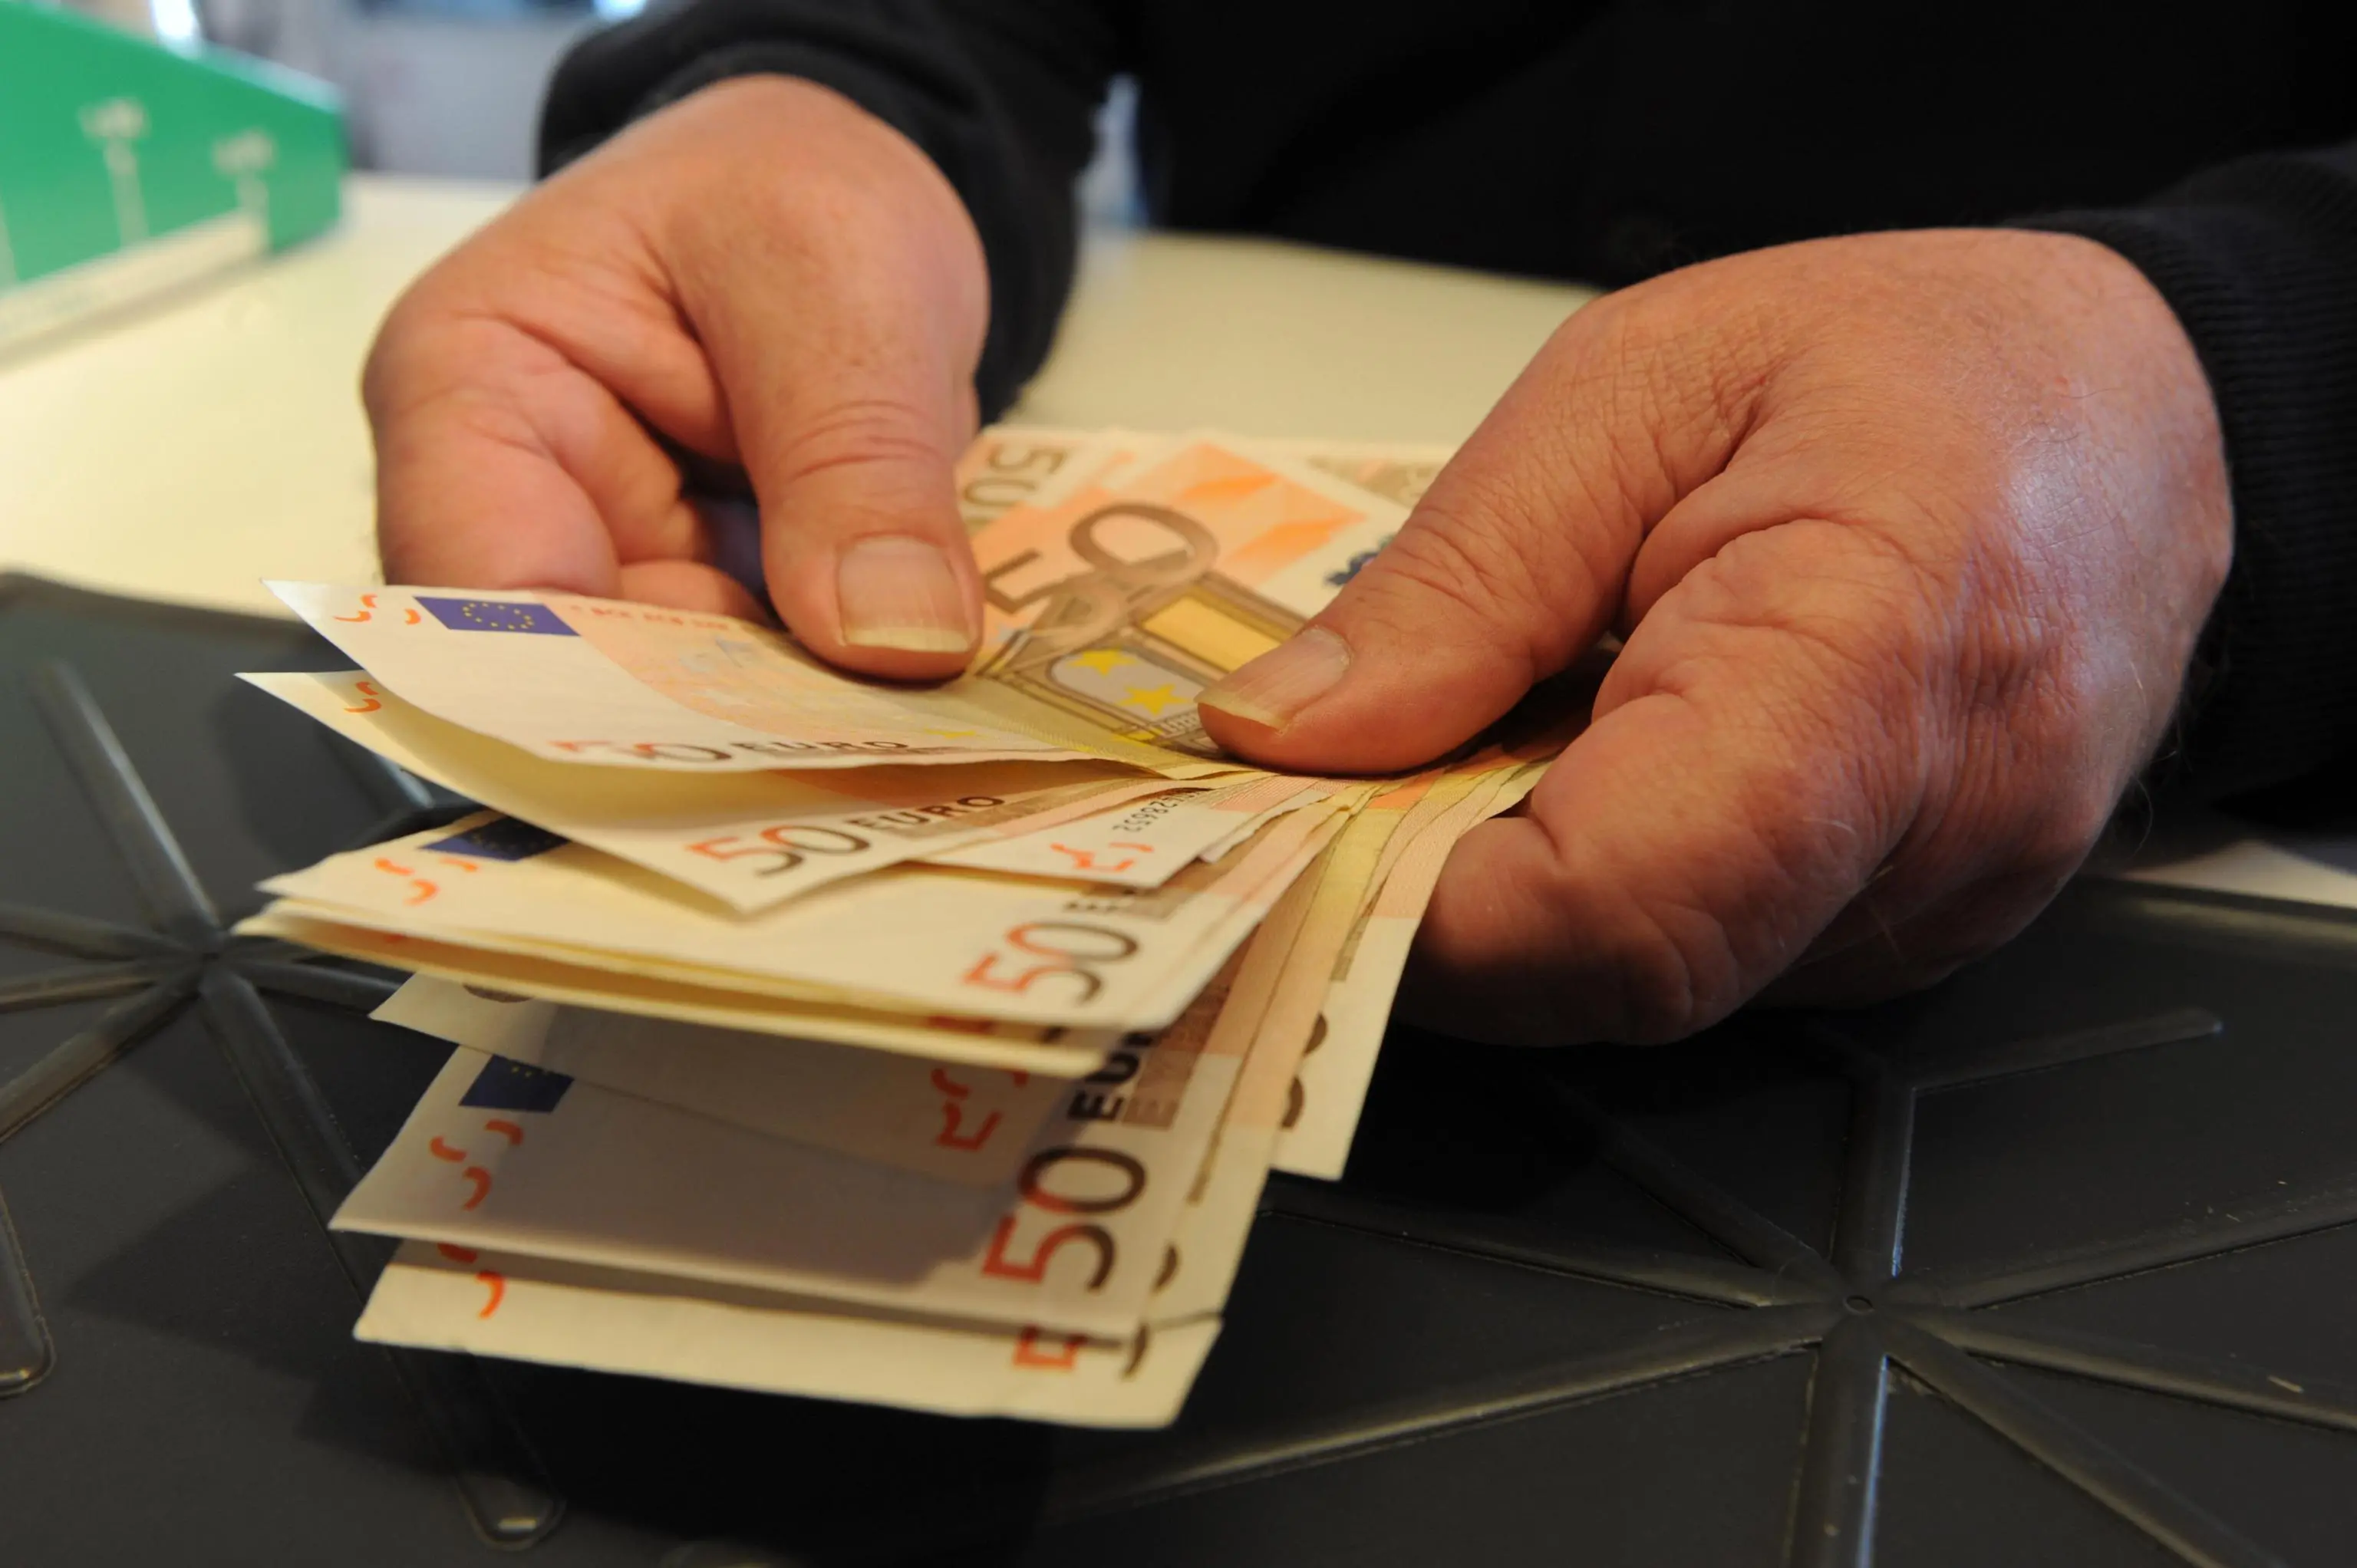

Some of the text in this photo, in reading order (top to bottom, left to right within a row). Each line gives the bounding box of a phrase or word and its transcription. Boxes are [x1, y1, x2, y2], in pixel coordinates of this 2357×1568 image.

[686, 796, 1006, 878] 50 EURO
[961, 921, 1139, 1006] 50
[981, 1146, 1146, 1293] 50
